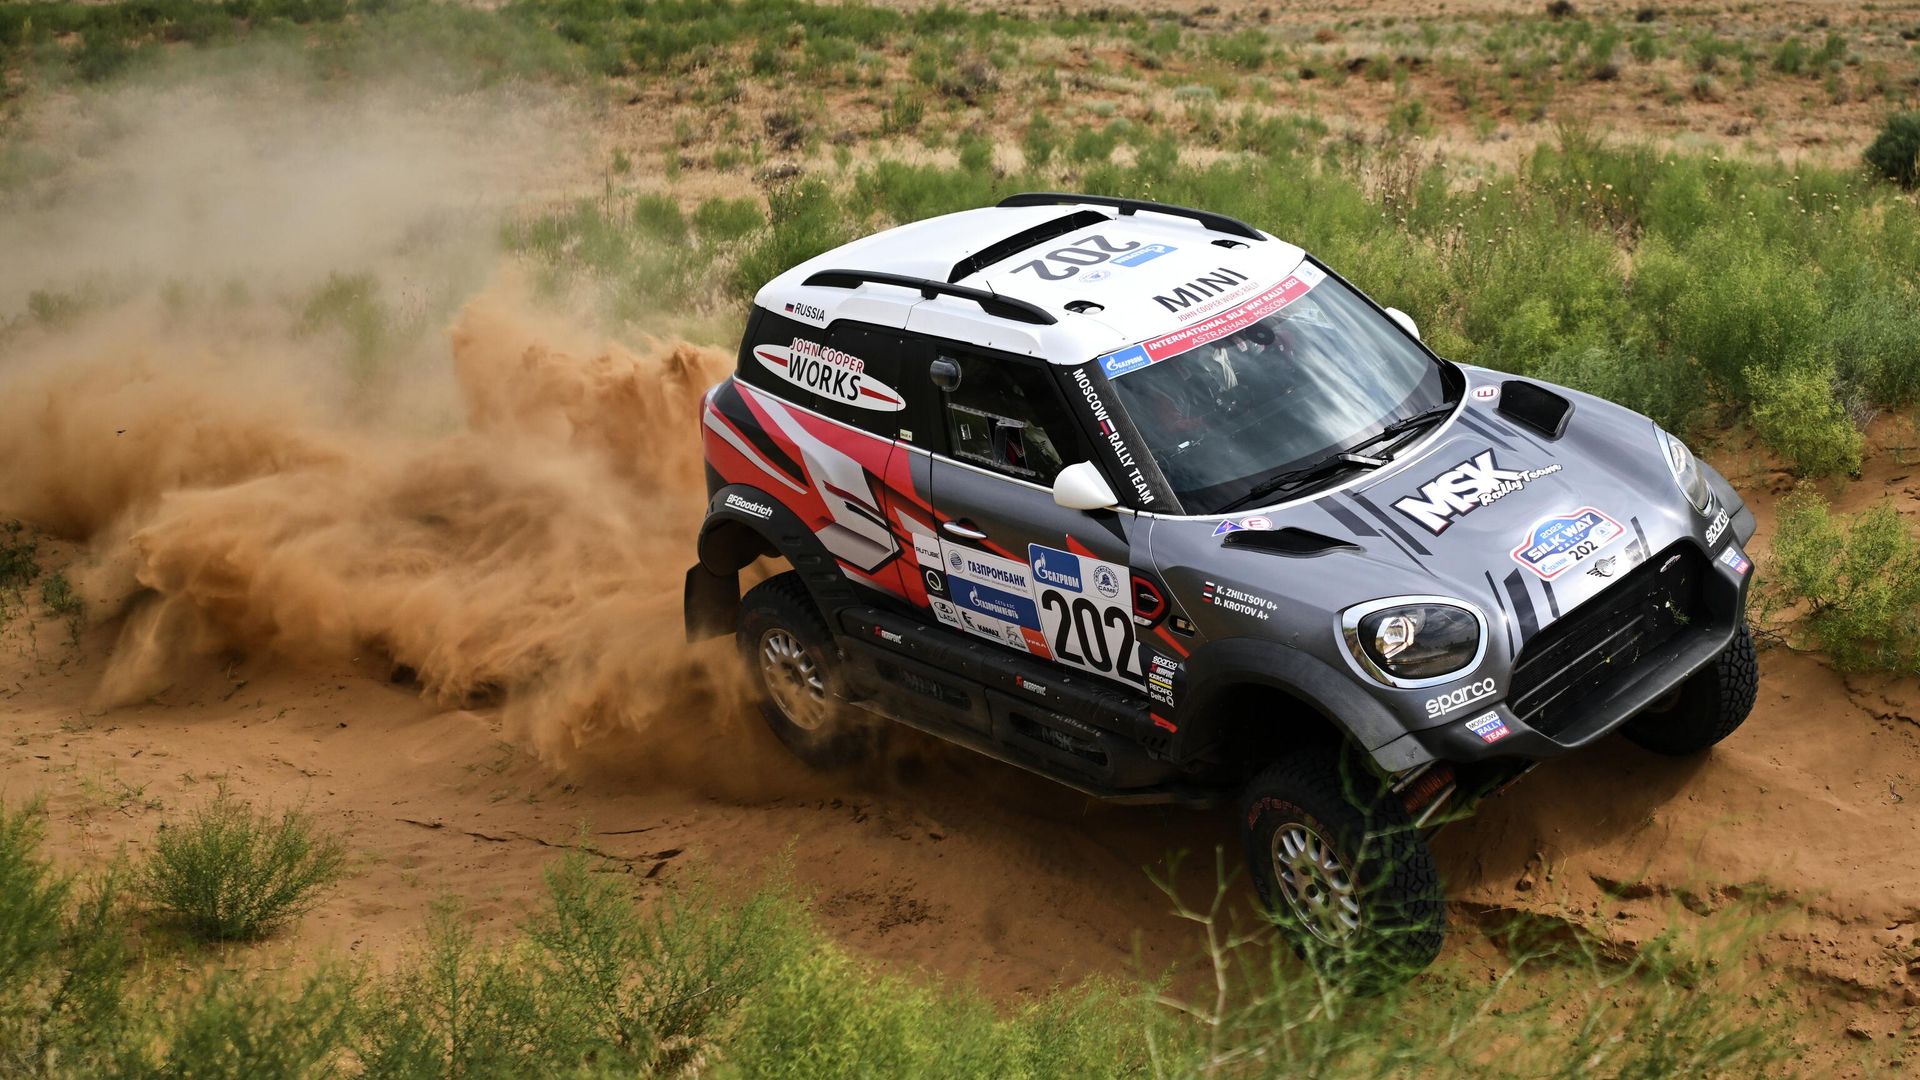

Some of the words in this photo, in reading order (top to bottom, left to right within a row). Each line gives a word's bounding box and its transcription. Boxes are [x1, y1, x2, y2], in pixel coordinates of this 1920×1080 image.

[1009, 234, 1141, 281] 202
[1152, 267, 1249, 313] MINI
[794, 302, 825, 322] RUSSIA
[1148, 319, 1225, 351] INTERNATIONAL
[1225, 307, 1247, 321] SILK
[1248, 297, 1265, 312] WAY
[1262, 286, 1285, 304] RALLY
[1283, 278, 1299, 291] 2022
[1178, 311, 1198, 322] JOHN
[1198, 300, 1222, 315] COOPER
[1221, 290, 1245, 306] WORKS
[1191, 318, 1249, 346] ASTRAKHAN
[1253, 297, 1288, 318] MOSCOW
[790, 336, 820, 357] JOHN
[820, 345, 864, 374] COOPER
[788, 352, 861, 401] WORKS
[1072, 368, 1109, 422] MOSCOW
[1107, 431, 1135, 468] RALLY
[1128, 467, 1155, 505] TEAM
[1391, 448, 1522, 535] MSK
[1478, 478, 1524, 507] Rally
[1518, 463, 1563, 482] Team
[725, 494, 773, 516] BFGoodrich
[1540, 522, 1565, 539] 2022
[1705, 507, 1728, 543] sparco
[1527, 534, 1566, 562] SILK
[1563, 514, 1595, 536] WAY
[1557, 532, 1585, 552] RALLY
[915, 546, 940, 559] RUTUBE
[1569, 540, 1599, 561] 202
[967, 560, 1027, 587] ГАЗПРОМБАНК
[1047, 570, 1080, 589] GAZPROM
[1216, 585, 1225, 595] K.
[1226, 588, 1266, 608] ZHILTSOV
[937, 611, 959, 624] LADA
[1214, 597, 1222, 606] D.
[1223, 599, 1258, 617] KROTOV
[1257, 610, 1269, 621] A+
[977, 624, 1000, 638] KAMAZ
[1041, 589, 1148, 688] 202
[1152, 656, 1178, 671] sparco
[1149, 683, 1173, 697] RECARO
[1150, 691, 1166, 703] Delta
[1425, 677, 1496, 716] sparco
[1468, 712, 1497, 729] MOSCOW
[1477, 719, 1502, 735] RALLY
[1486, 728, 1508, 742] TEAM
